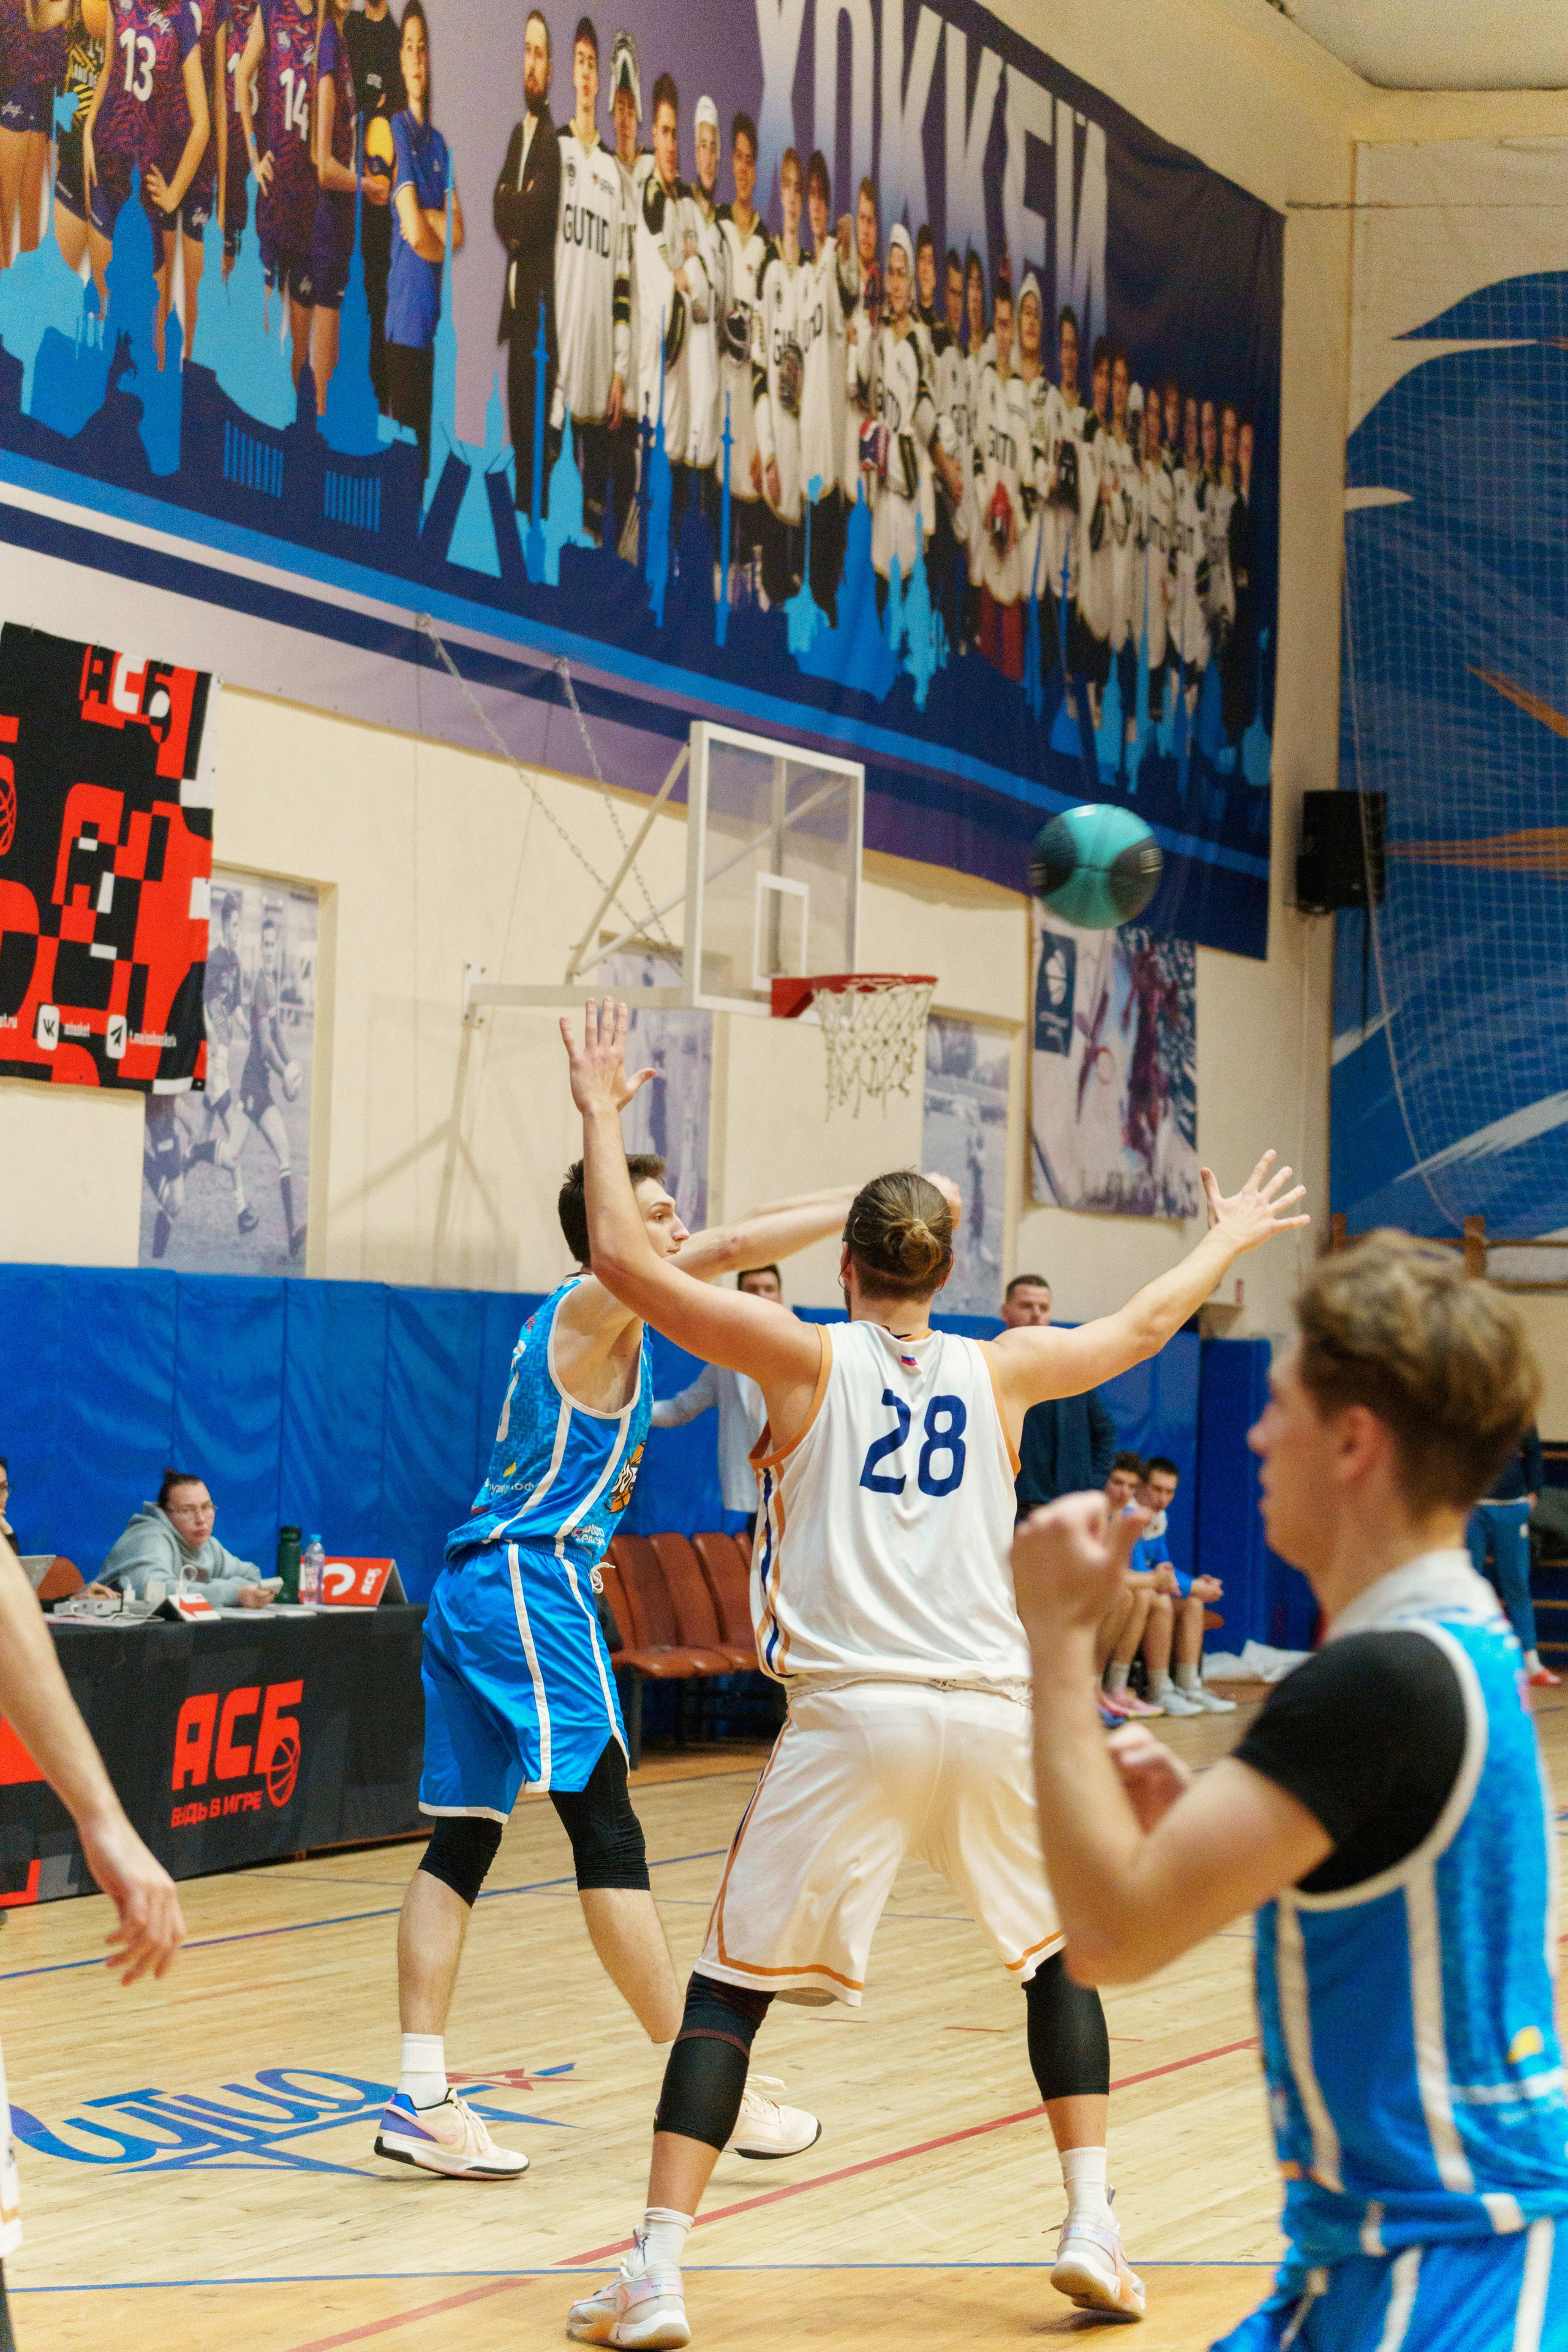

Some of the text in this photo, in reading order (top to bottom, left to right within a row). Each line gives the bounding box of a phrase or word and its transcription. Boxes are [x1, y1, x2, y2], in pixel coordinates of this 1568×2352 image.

[119, 28, 157, 102] 13
[279, 67, 309, 142] 14
[859, 1389, 967, 1497] 28
[172, 1679, 304, 1807] АСБ
[209, 1798, 221, 1819] В
[222, 1790, 263, 1815] ИГРЕ
